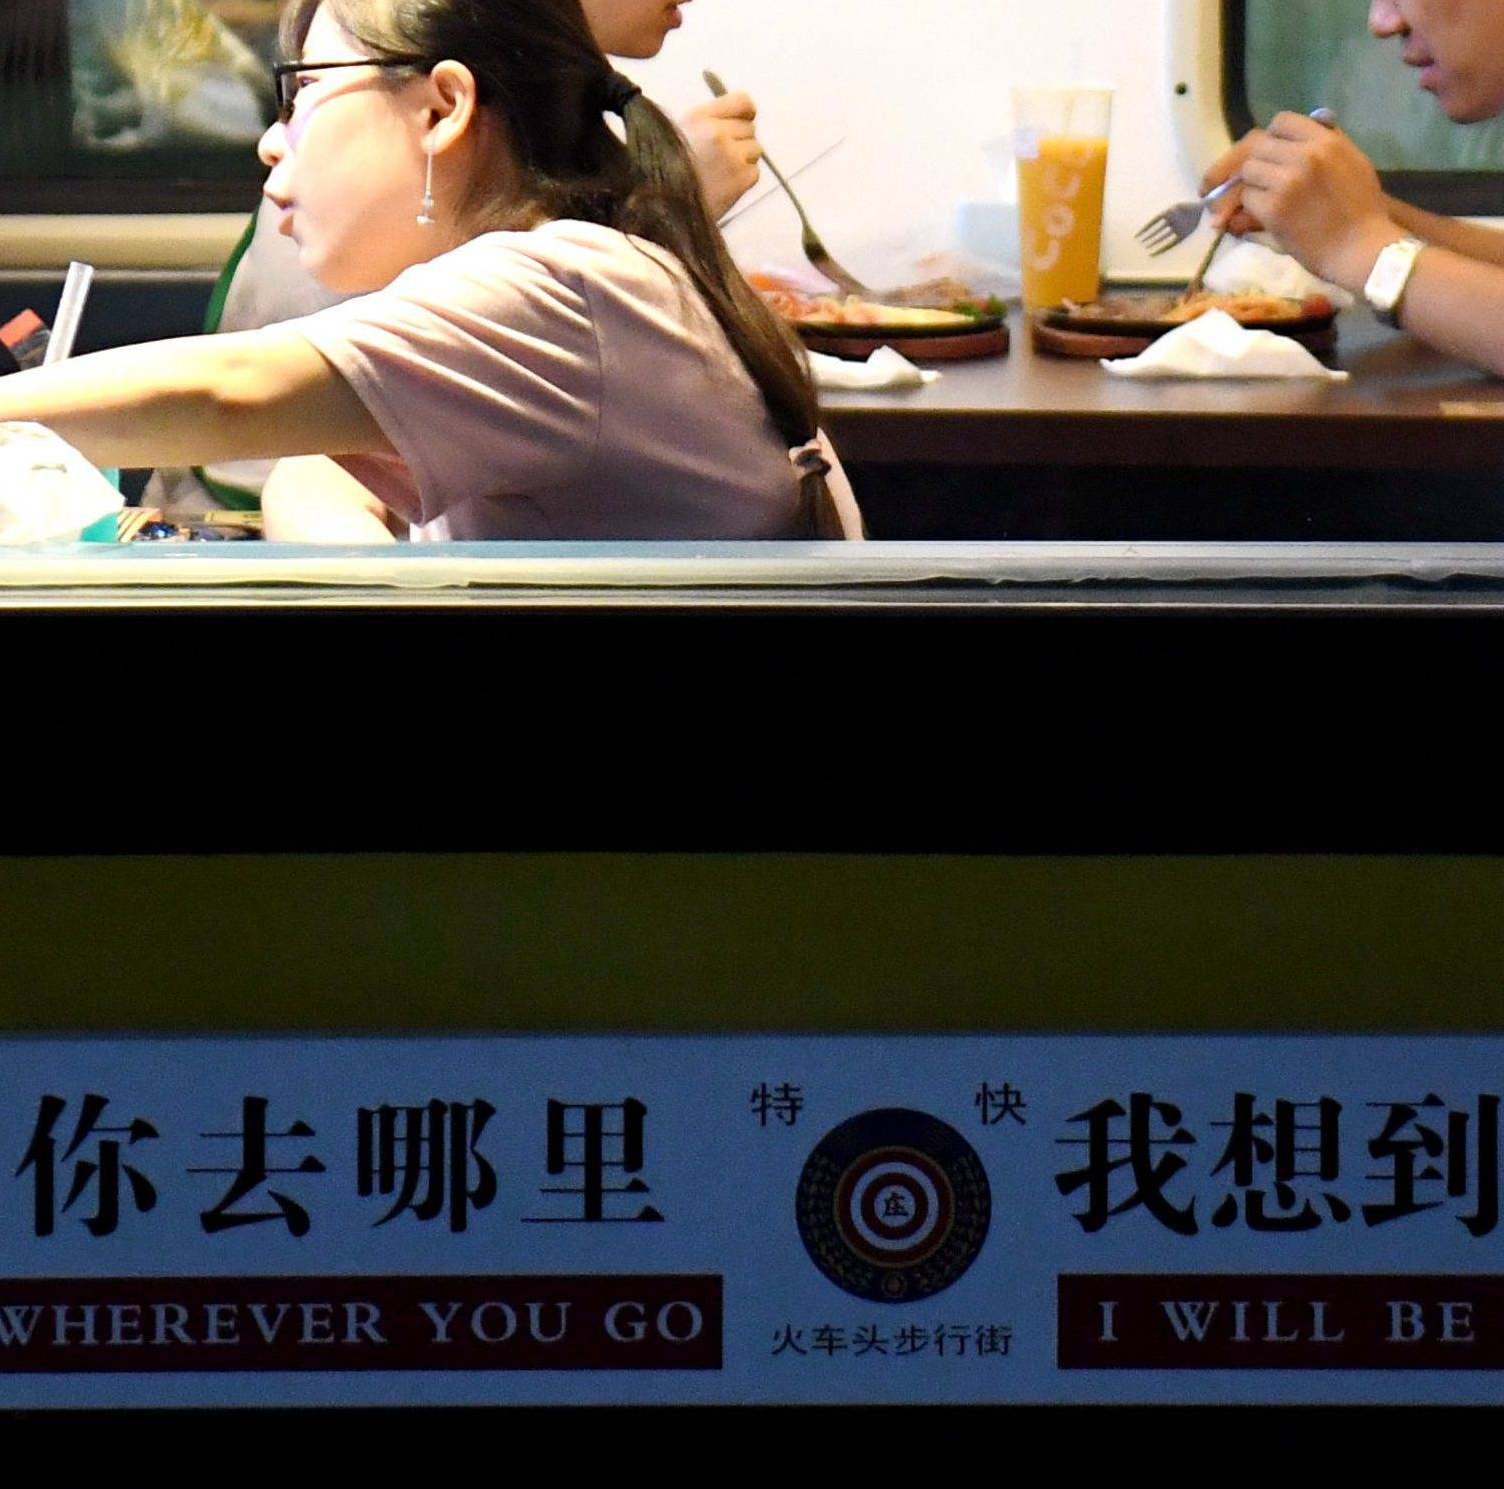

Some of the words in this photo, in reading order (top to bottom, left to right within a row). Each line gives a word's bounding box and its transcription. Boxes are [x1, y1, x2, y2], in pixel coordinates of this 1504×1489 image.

[750, 1081, 804, 1127] 特
[974, 1081, 1028, 1127] 快
[14, 1093, 665, 1238] 你去哪里
[419, 1300, 572, 1346] YOU
[603, 1300, 704, 1345] GO
[770, 1322, 1013, 1358] 火车头步行街
[1098, 1301, 1119, 1344] I
[1161, 1300, 1346, 1344] WILL
[1385, 1301, 1476, 1344] BE
